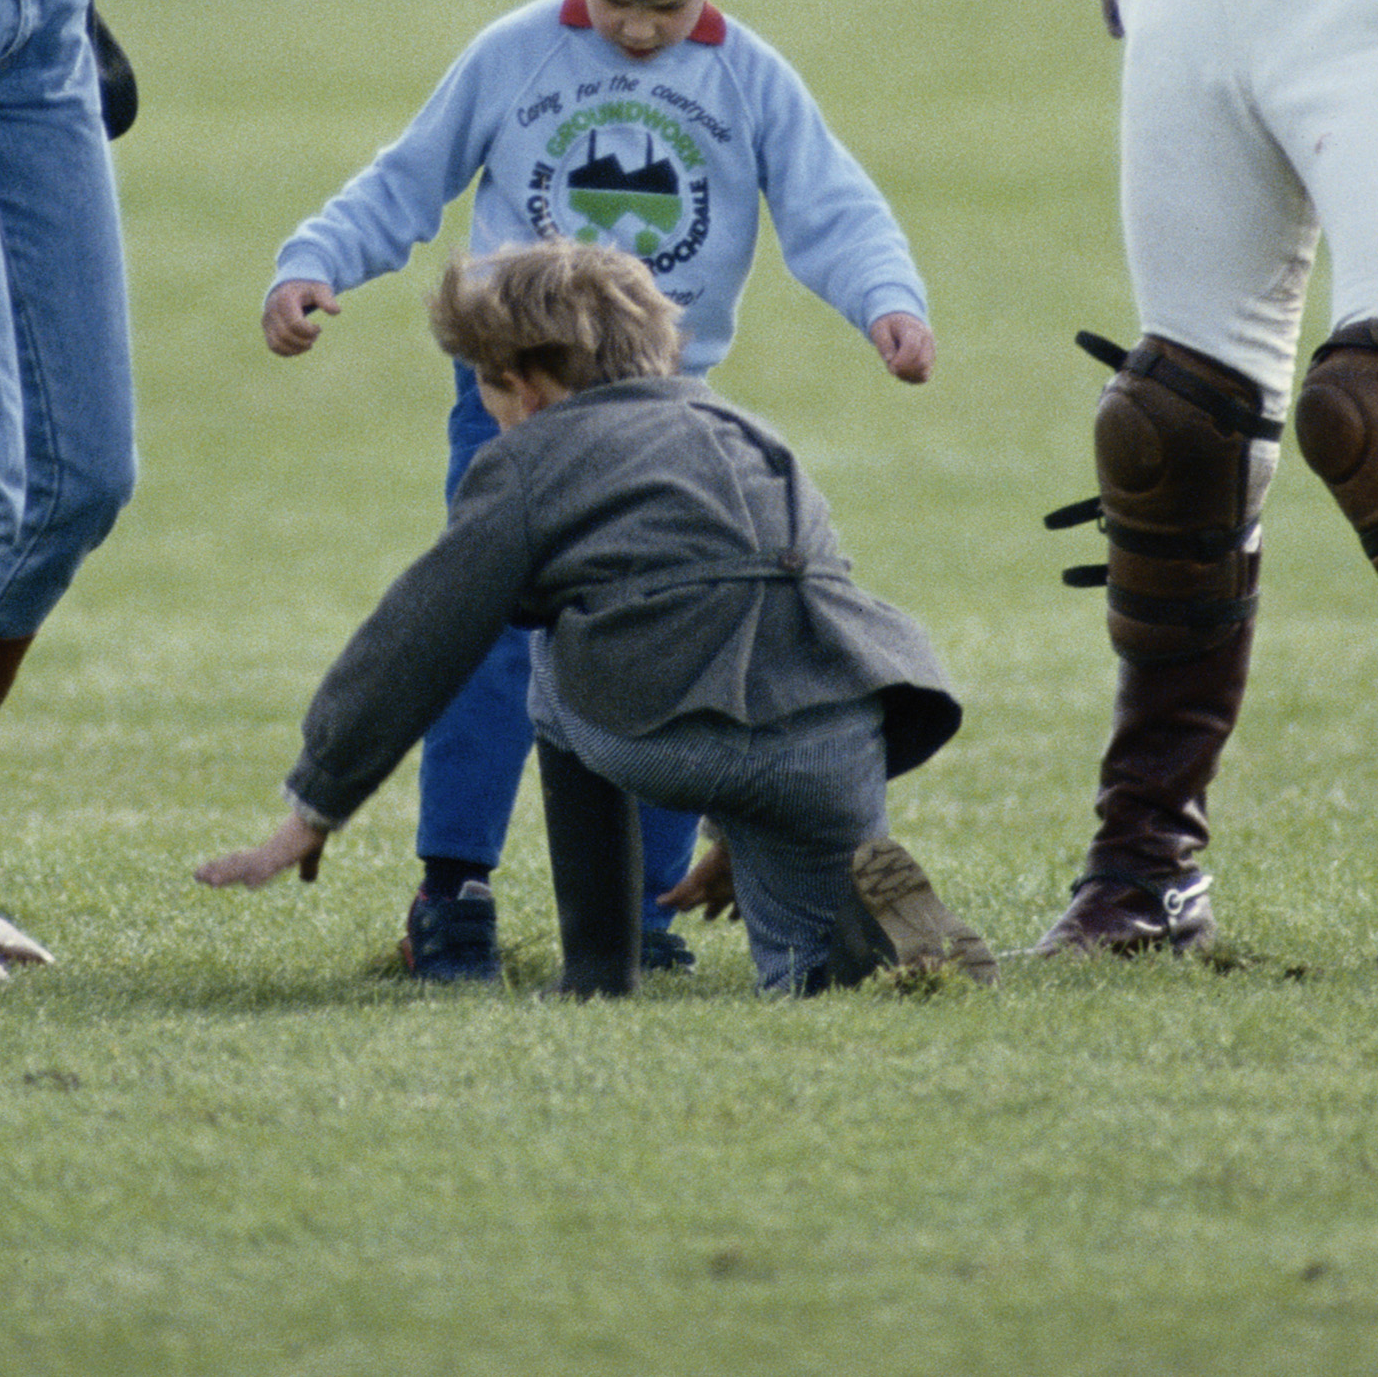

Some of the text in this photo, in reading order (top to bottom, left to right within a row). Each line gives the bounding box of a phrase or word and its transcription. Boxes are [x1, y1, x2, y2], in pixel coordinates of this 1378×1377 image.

[517, 75, 732, 143] Caring for the countryside
[546, 100, 707, 171] GROUNDWORK
